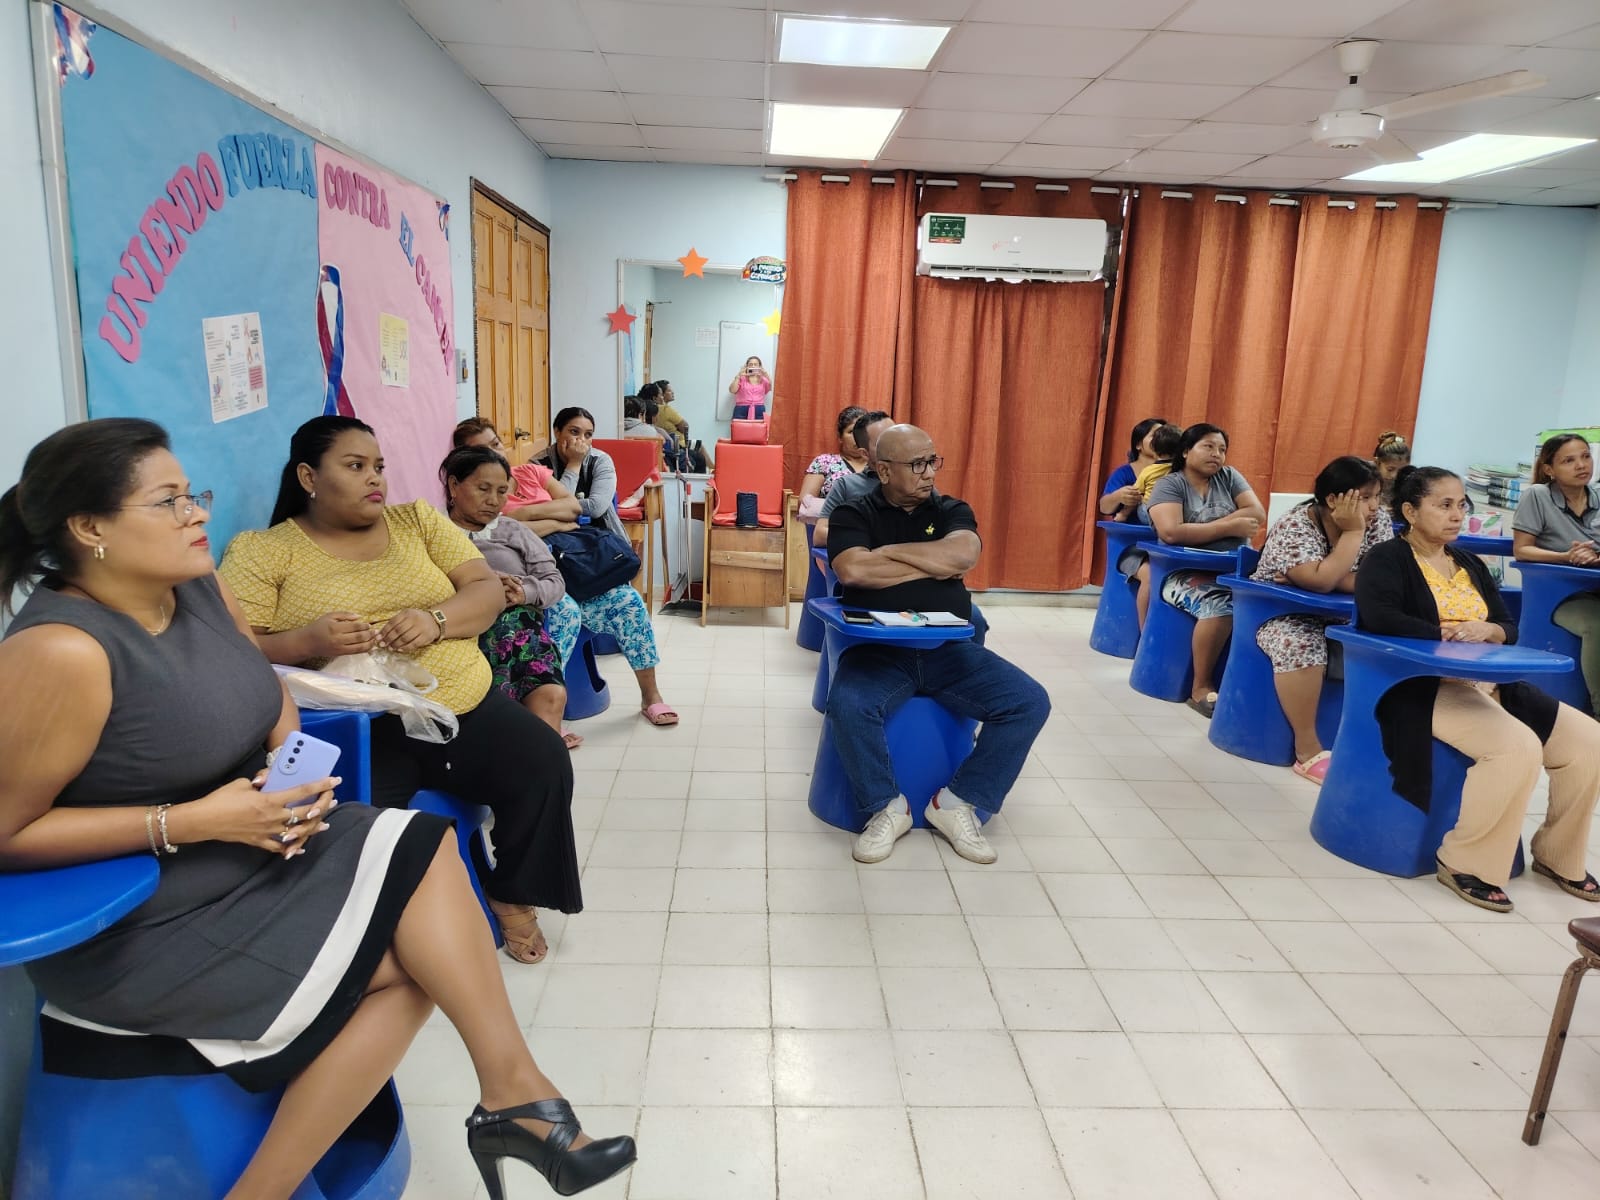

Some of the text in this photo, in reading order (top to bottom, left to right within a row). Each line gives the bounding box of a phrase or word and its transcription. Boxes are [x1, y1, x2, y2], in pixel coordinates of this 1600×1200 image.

[100, 152, 225, 363] UNIENDO
[218, 133, 317, 199] FUERZA
[323, 162, 391, 230] CONTRA
[399, 211, 415, 267] EL
